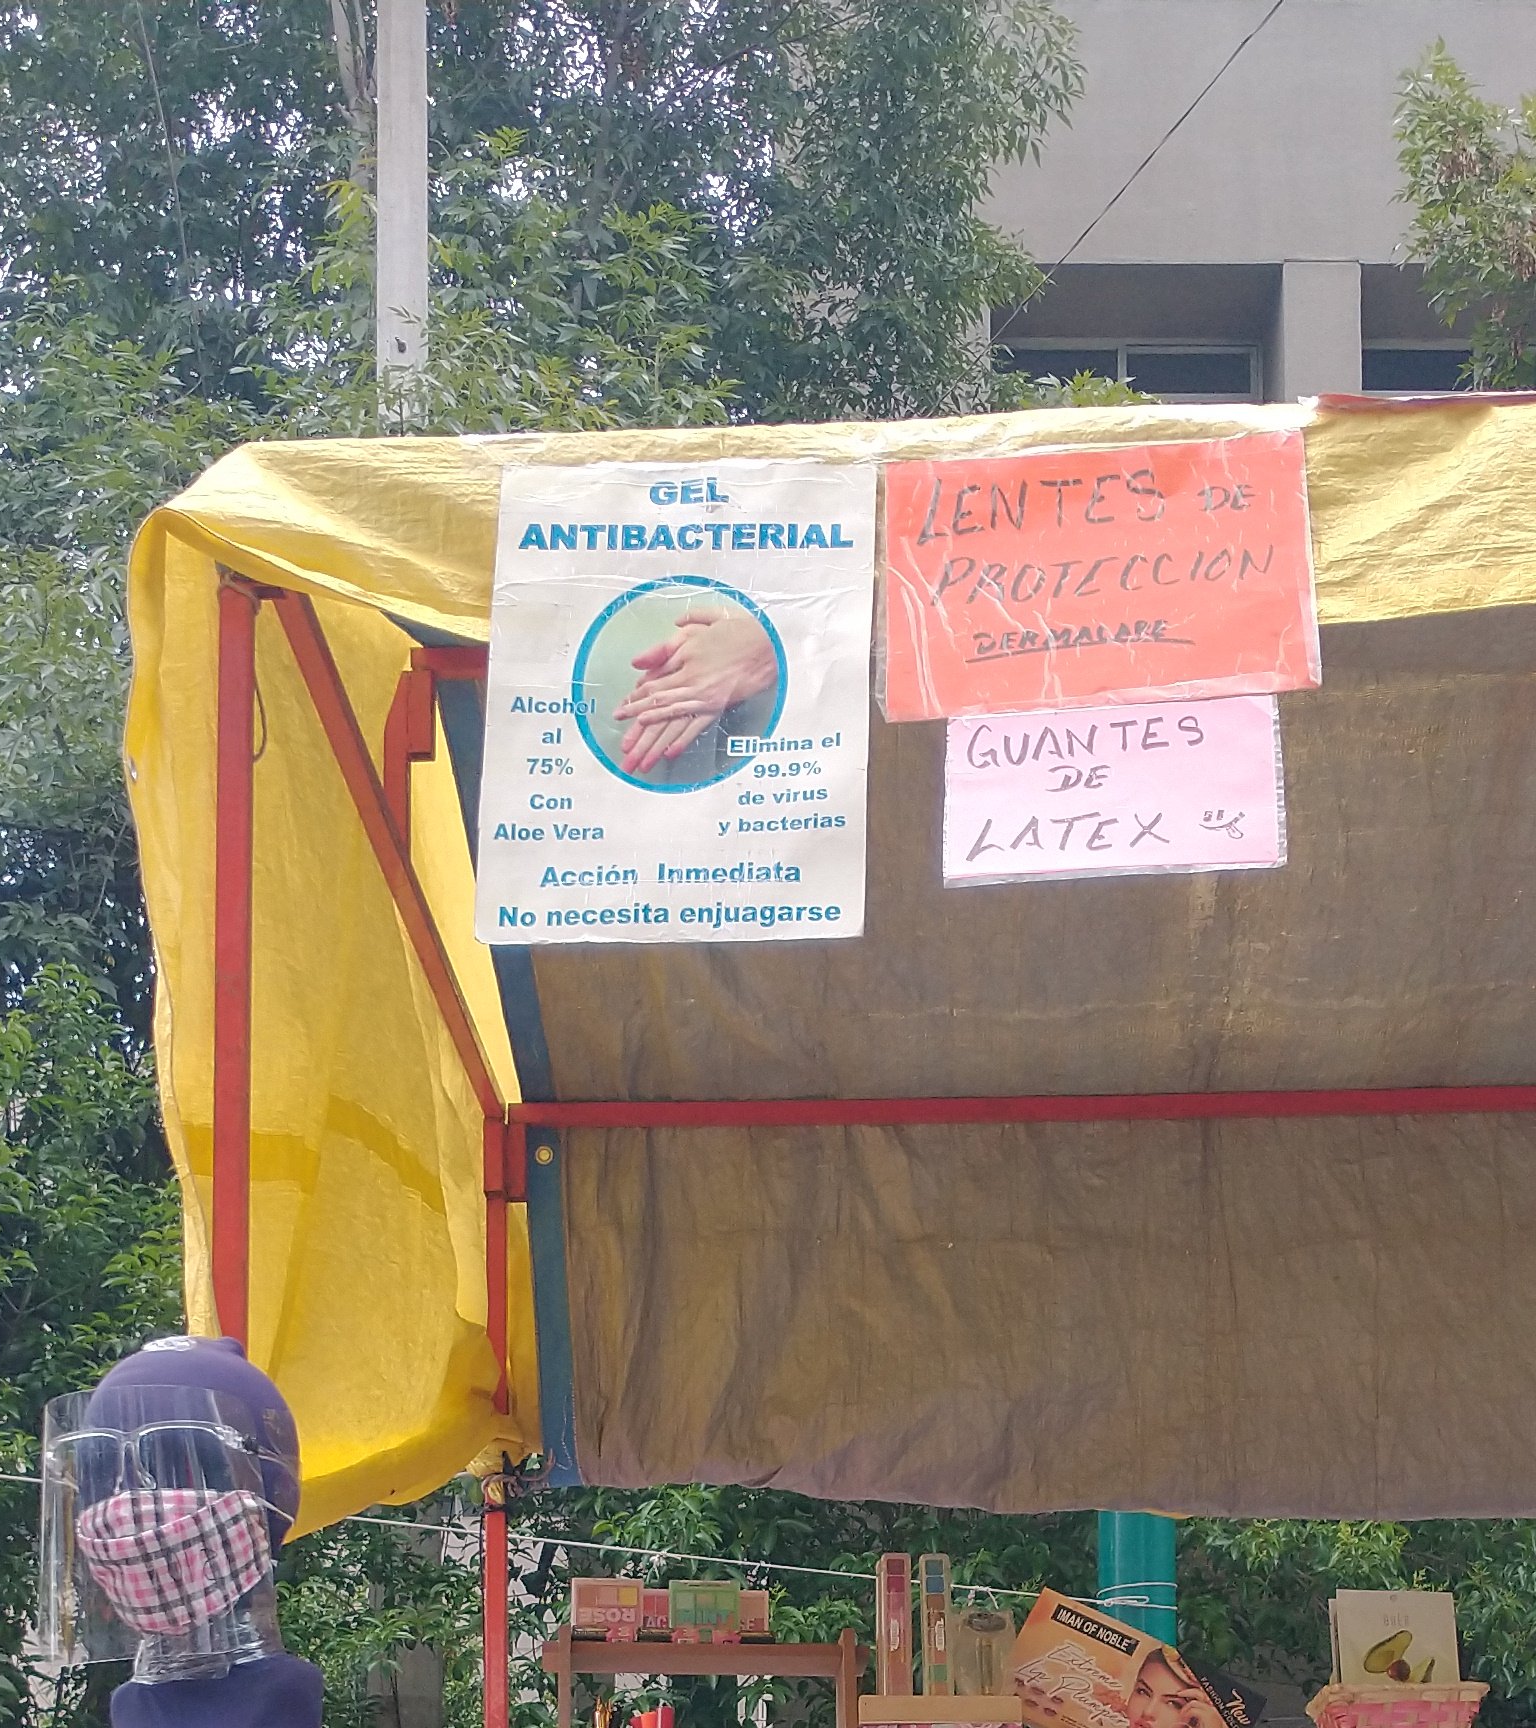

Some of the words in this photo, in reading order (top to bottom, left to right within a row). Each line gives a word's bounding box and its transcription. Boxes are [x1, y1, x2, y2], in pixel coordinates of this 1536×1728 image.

[649, 477, 730, 506] GEL
[917, 469, 1165, 546] LENTES
[1199, 484, 1255, 512] DE
[518, 523, 854, 551] ANTIBACTERIAL
[931, 544, 1273, 606] PROTECCION
[511, 697, 595, 715] Alcohol
[541, 728, 562, 745] al
[729, 737, 814, 754] Elimina
[821, 732, 841, 749] el
[967, 716, 1204, 768] GUANTES
[527, 758, 574, 776] 75%
[753, 760, 822, 779] 99.9%
[1046, 765, 1110, 792] DE
[530, 794, 572, 810] Con
[738, 790, 764, 806] de
[772, 786, 828, 804] virus
[494, 823, 545, 841] Aloe
[553, 824, 604, 841] Vera
[718, 820, 731, 837] y
[738, 814, 846, 833] bacterias
[966, 811, 1170, 862] LATEX
[540, 866, 638, 887] Acción
[657, 861, 801, 884] Inmediata
[498, 906, 537, 928] No
[546, 902, 669, 927] necesita
[680, 901, 841, 928] enjuagarse
[1056, 1608, 1081, 1630] IMAN
[1083, 1620, 1097, 1636] OF
[1097, 1627, 1129, 1651] NOBLE
